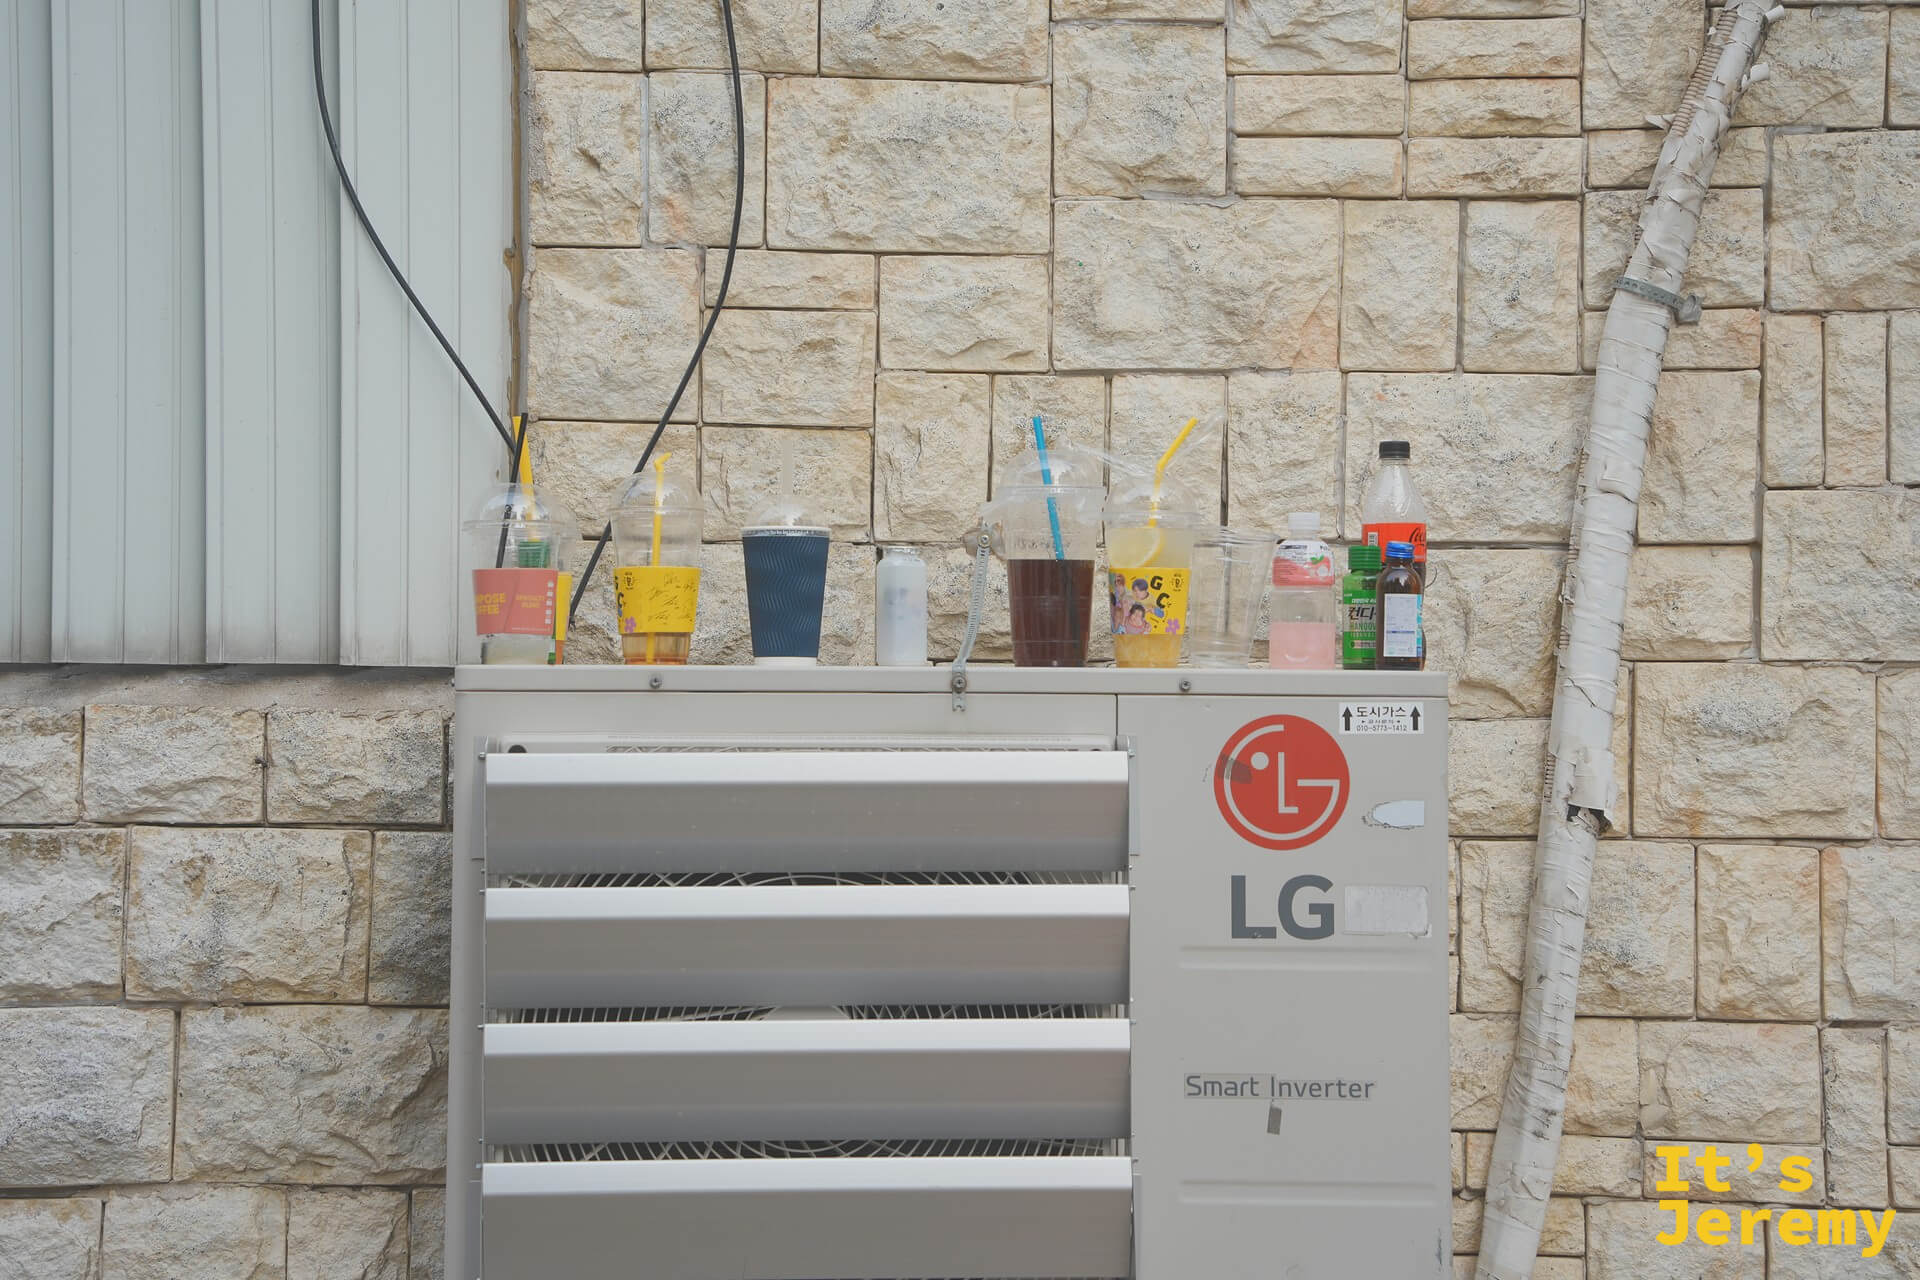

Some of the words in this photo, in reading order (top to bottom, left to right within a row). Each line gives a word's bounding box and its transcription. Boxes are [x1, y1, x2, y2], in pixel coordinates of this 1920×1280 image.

[1356, 706, 1407, 718] 도시가스
[1231, 874, 1335, 941] LG
[1186, 1075, 1260, 1097] Smart
[1271, 1076, 1375, 1099] Inverter
